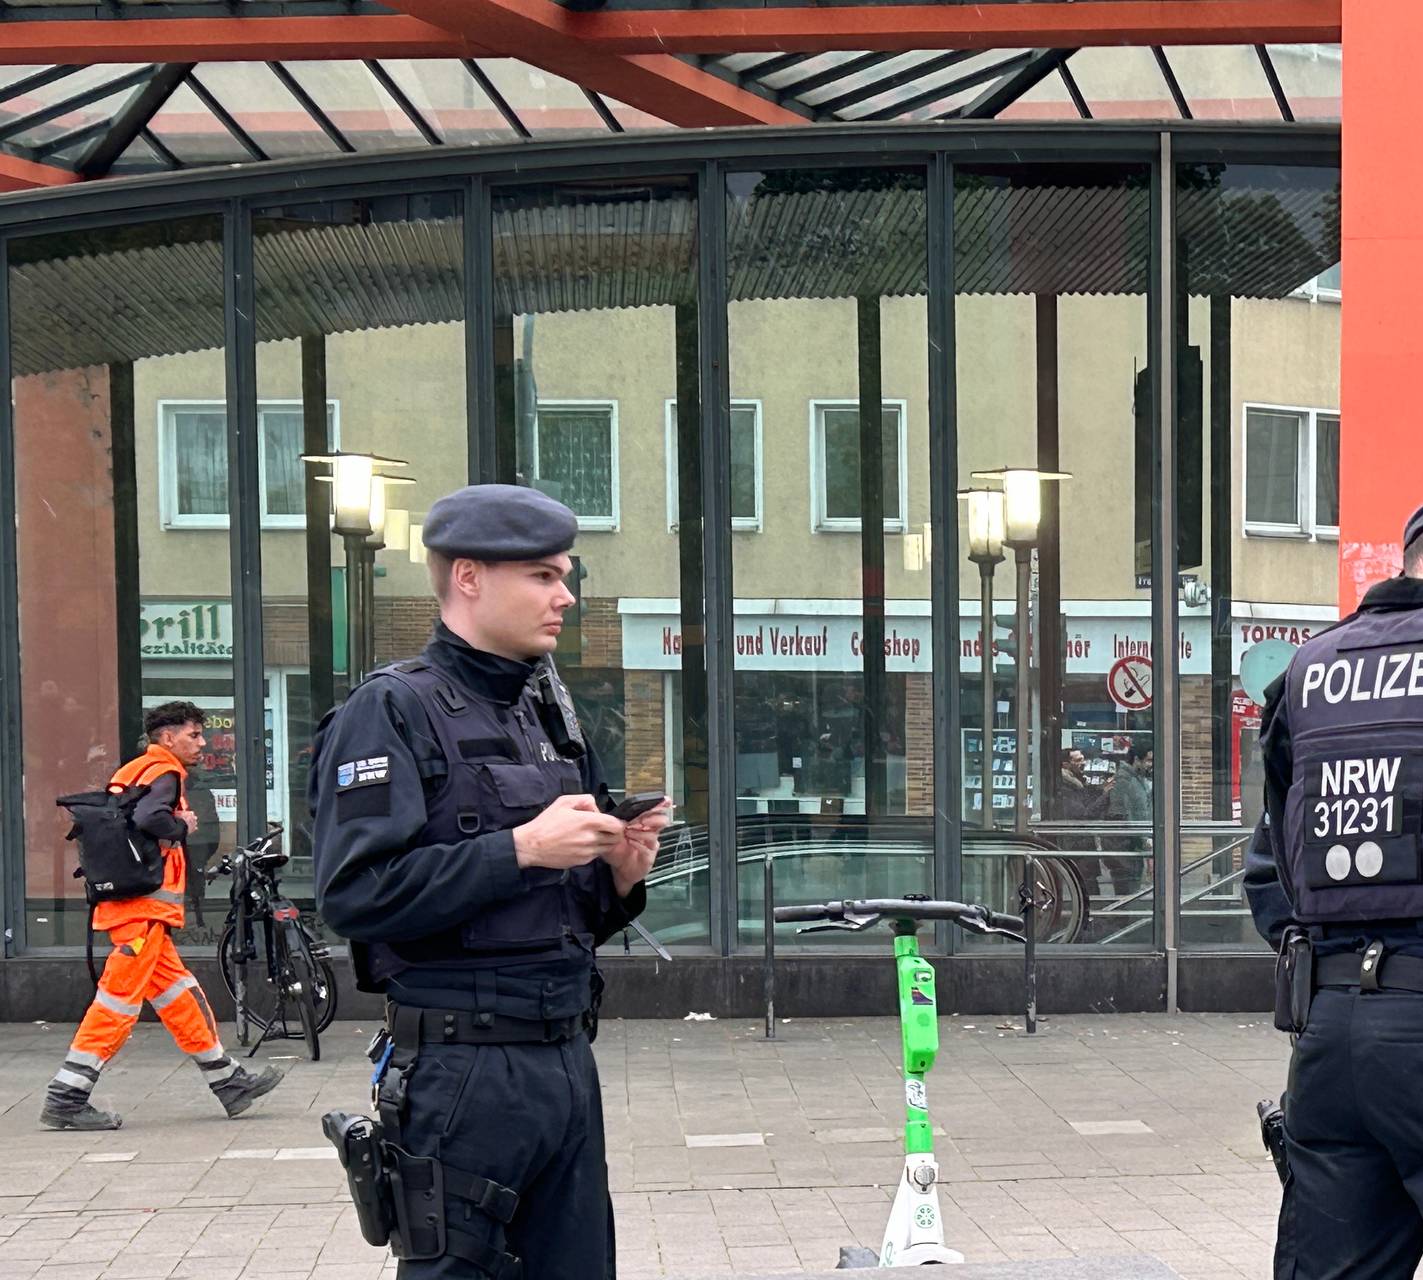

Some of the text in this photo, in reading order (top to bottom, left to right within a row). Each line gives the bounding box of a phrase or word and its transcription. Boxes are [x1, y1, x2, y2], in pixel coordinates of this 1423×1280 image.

[736, 625, 763, 655] und
[769, 625, 828, 656] Verkauf
[851, 629, 920, 663] Cshop
[1321, 757, 1402, 797] NRW
[1314, 796, 1394, 838] 31231
